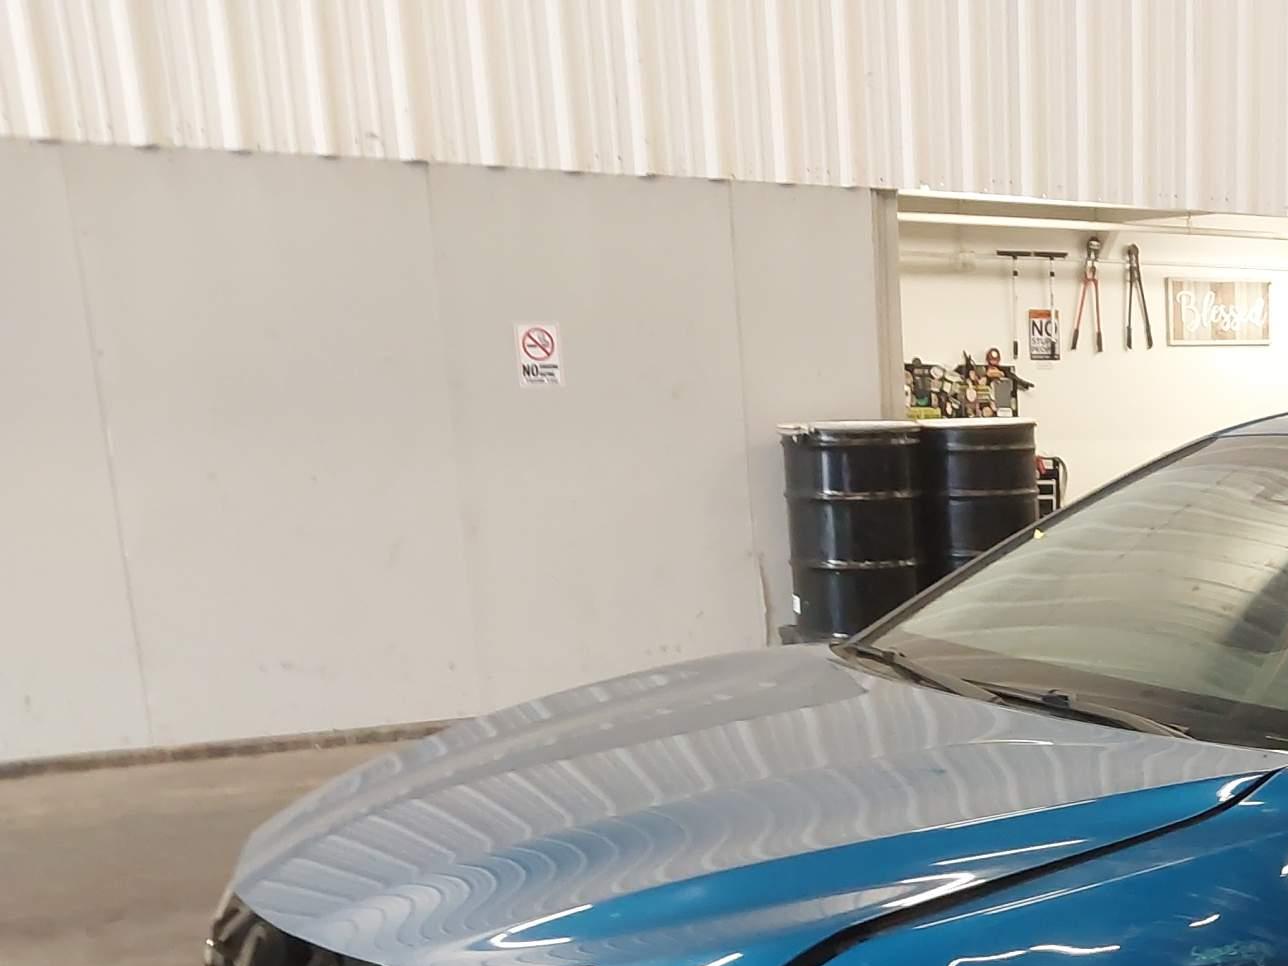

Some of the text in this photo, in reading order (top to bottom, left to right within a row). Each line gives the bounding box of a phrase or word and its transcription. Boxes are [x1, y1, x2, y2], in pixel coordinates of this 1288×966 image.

[1175, 290, 1266, 332] Blessed
[1031, 319, 1058, 336] NO
[522, 363, 539, 377] NO
